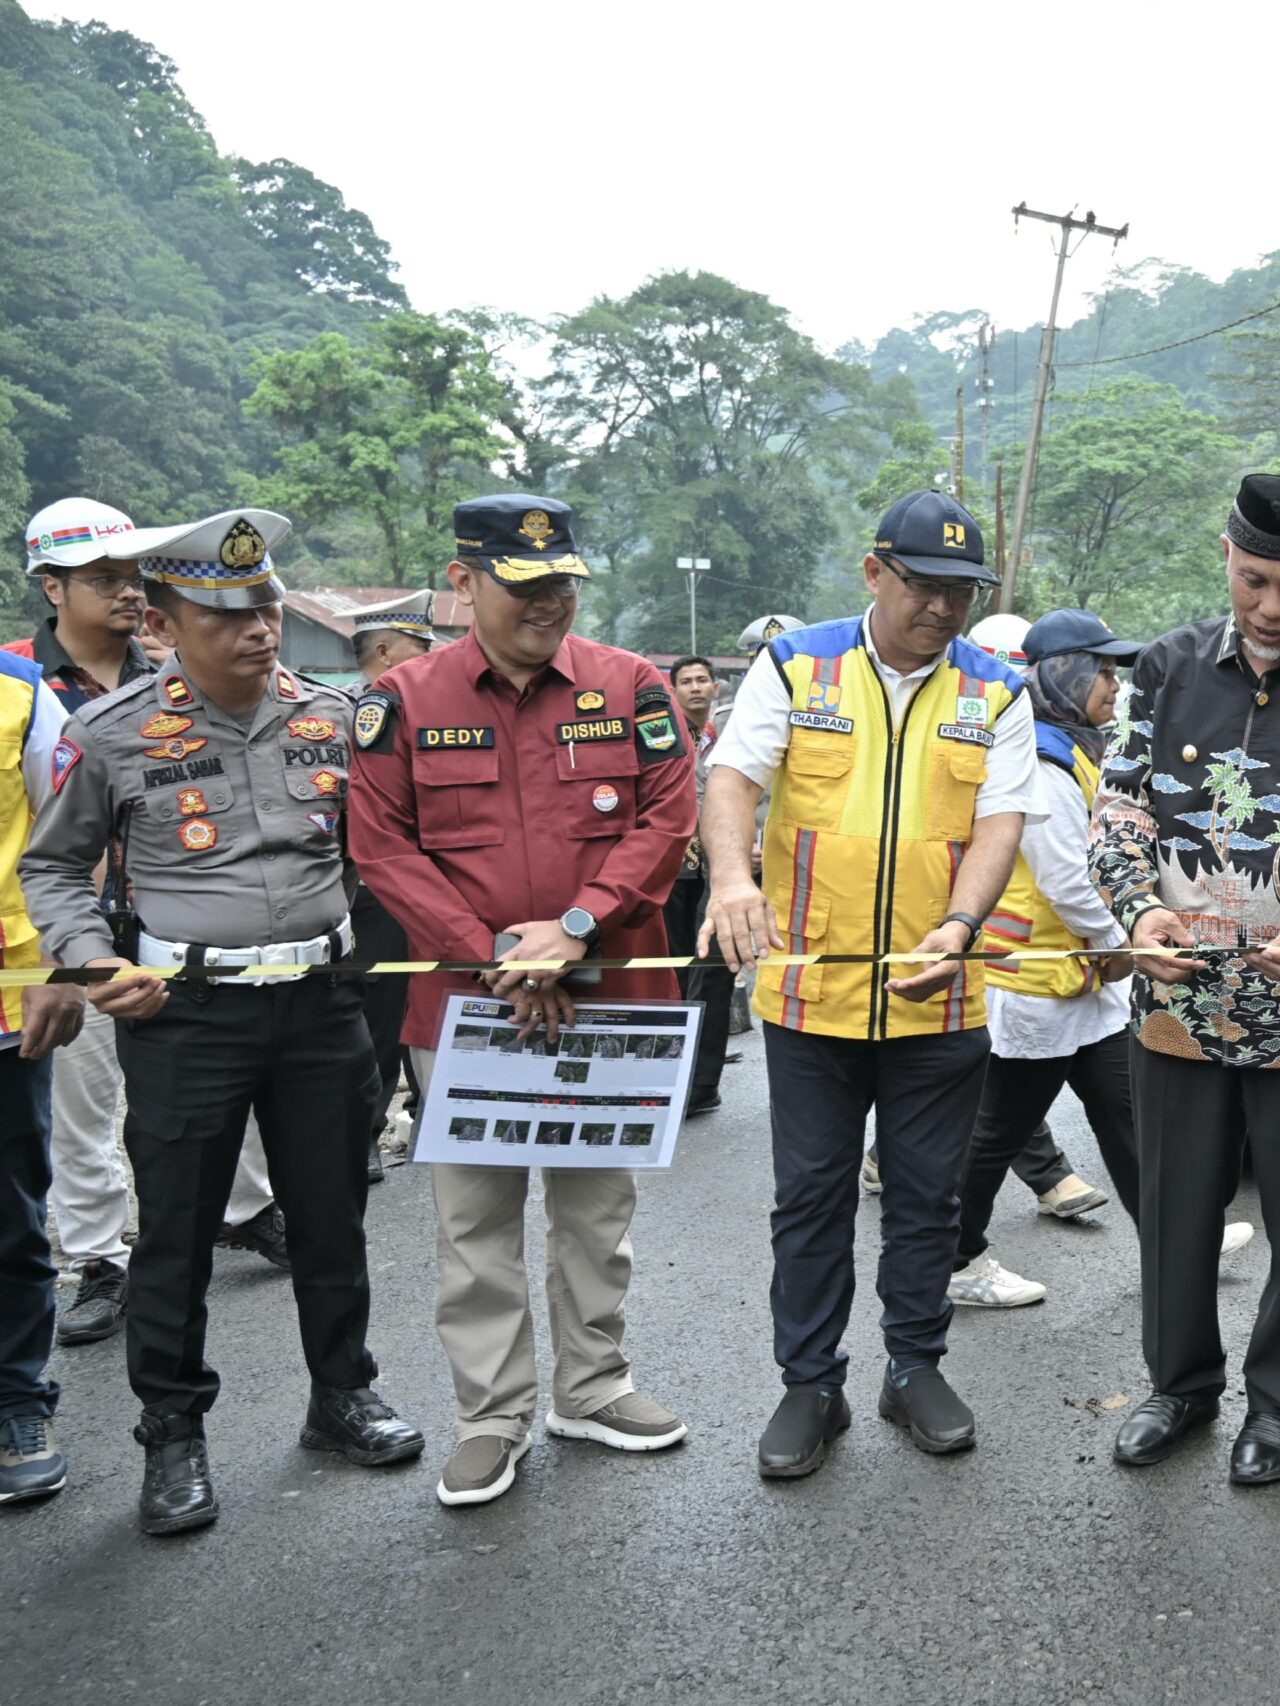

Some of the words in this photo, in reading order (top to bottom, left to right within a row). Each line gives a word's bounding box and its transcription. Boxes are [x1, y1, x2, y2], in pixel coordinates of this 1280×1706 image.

[561, 720, 623, 740] DISHUB
[793, 713, 850, 730] THABRANI
[427, 729, 484, 745] DEDY
[942, 726, 976, 739] KEPALA
[283, 748, 345, 767] POLRI
